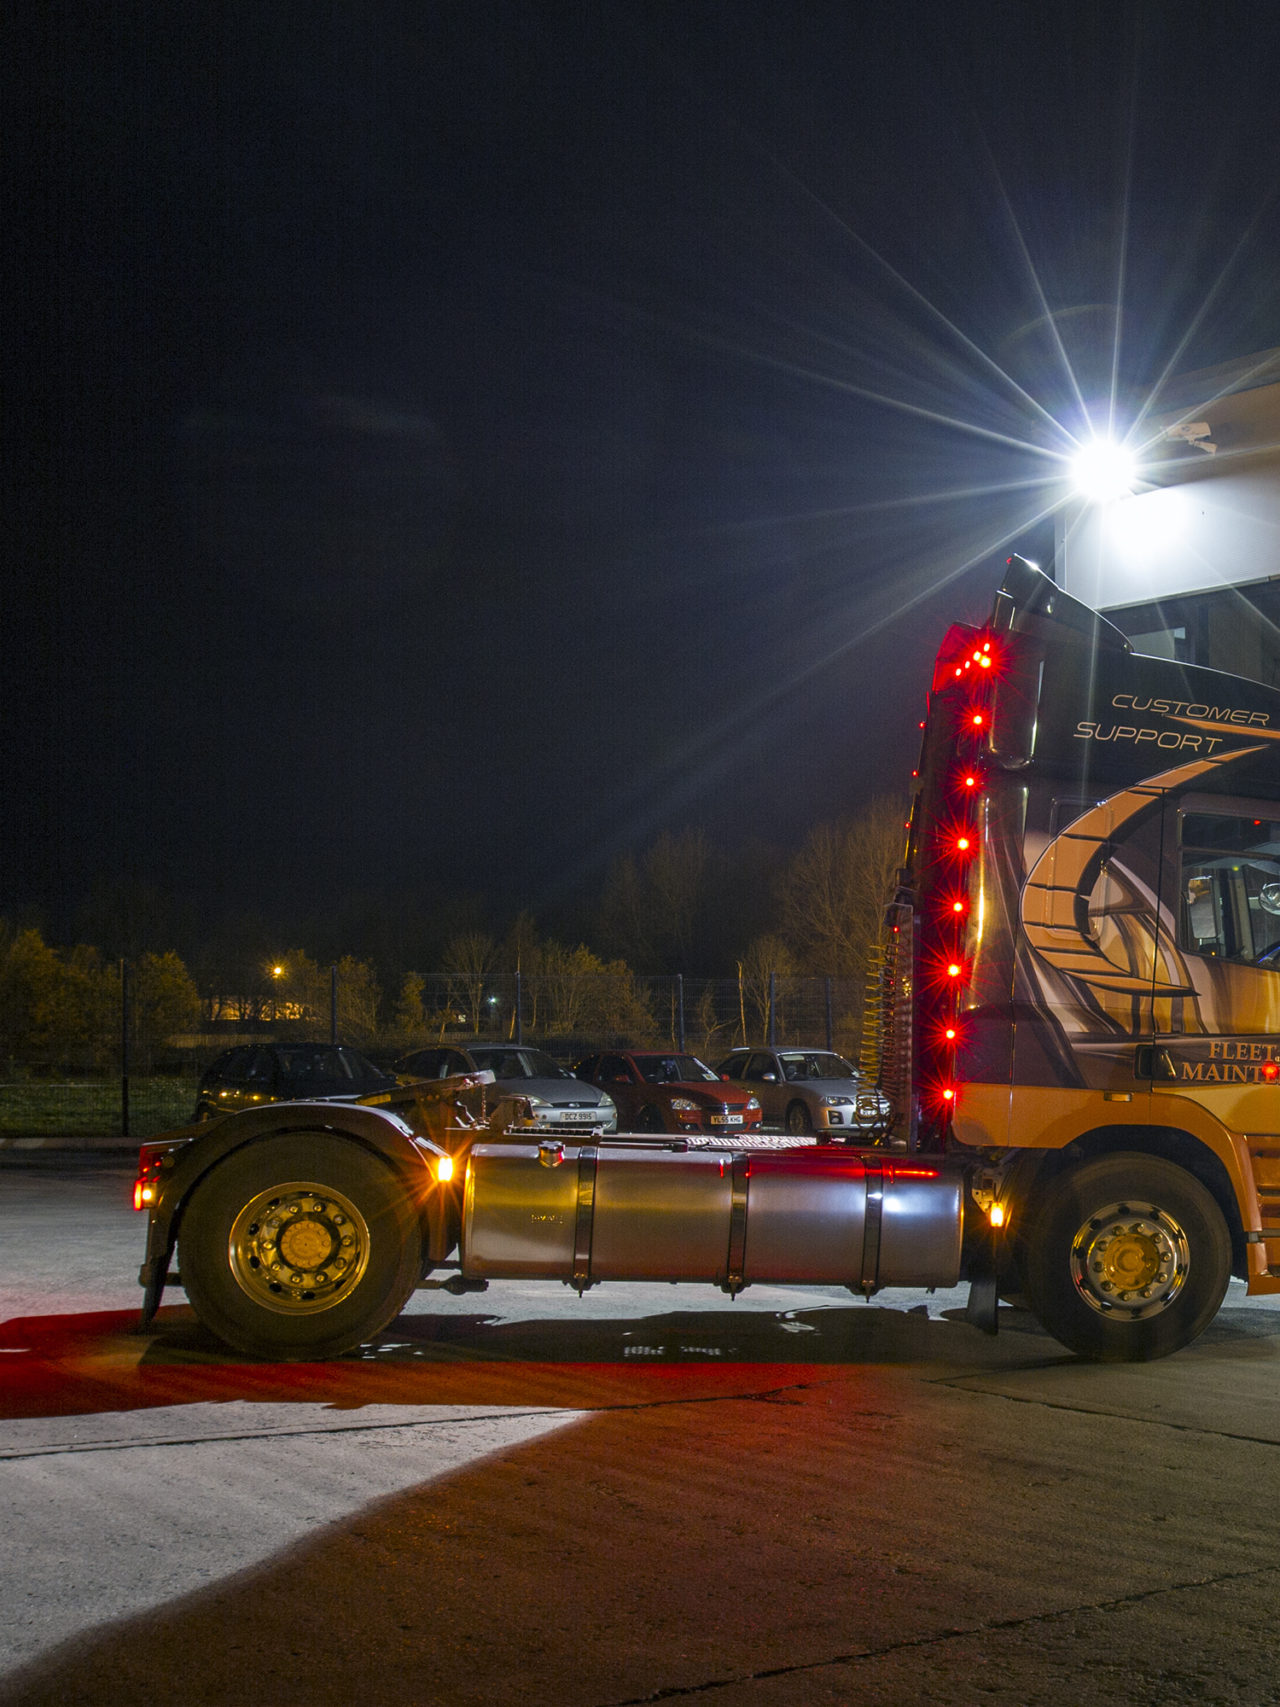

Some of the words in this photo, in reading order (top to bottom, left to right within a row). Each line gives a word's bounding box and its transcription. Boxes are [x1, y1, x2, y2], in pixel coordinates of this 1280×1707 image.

[1112, 694, 1270, 726] CUSTOMER
[1073, 721, 1223, 753] SUPPORT
[1208, 1041, 1277, 1062] FLEET
